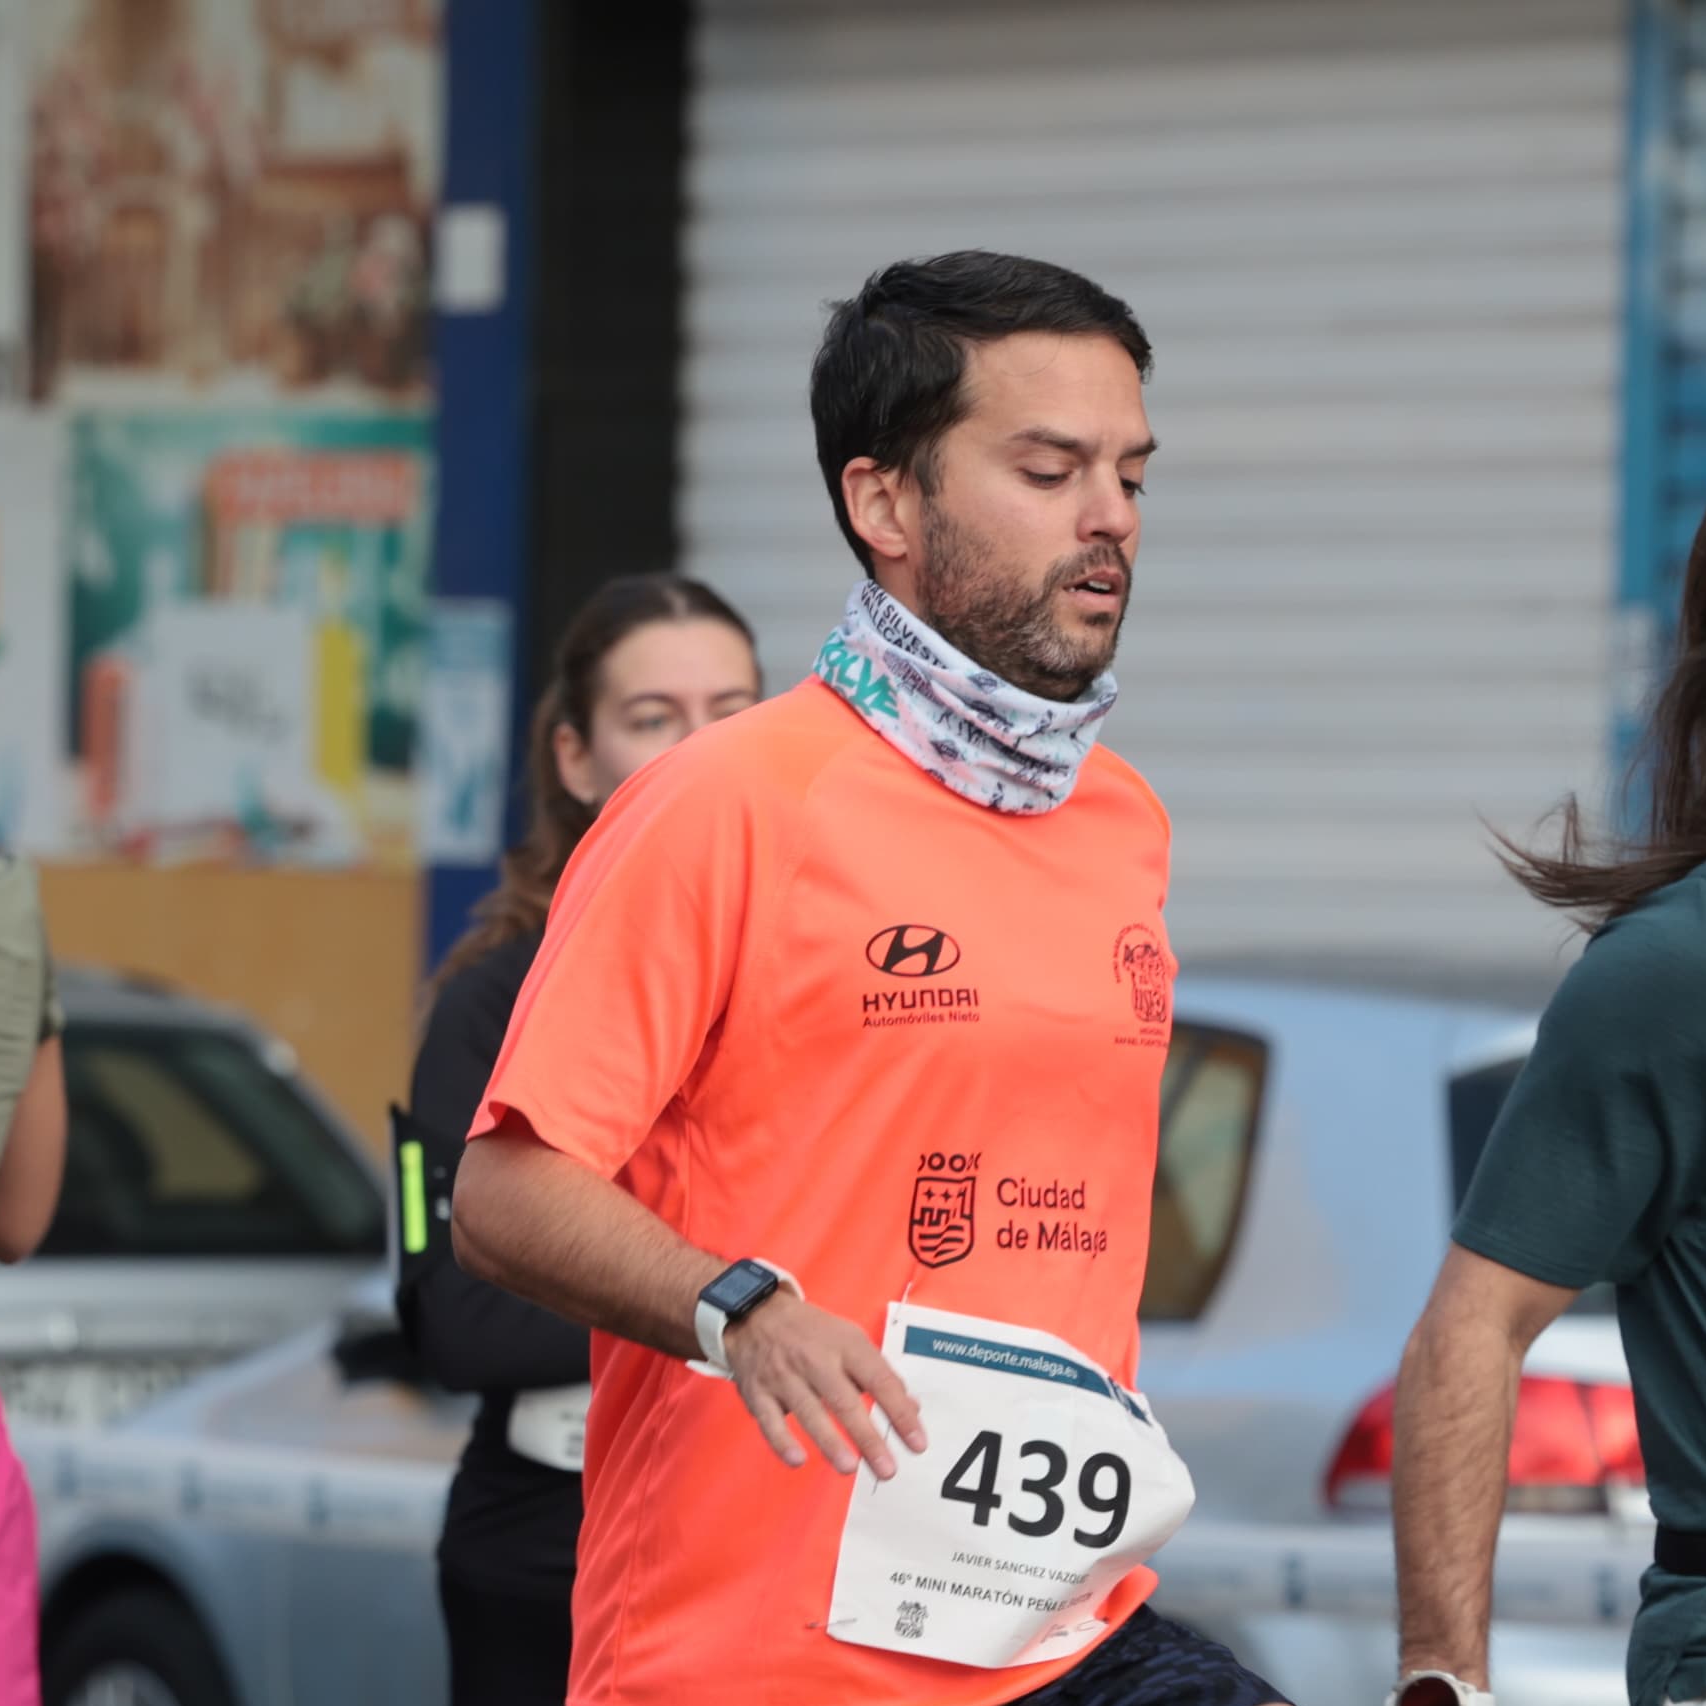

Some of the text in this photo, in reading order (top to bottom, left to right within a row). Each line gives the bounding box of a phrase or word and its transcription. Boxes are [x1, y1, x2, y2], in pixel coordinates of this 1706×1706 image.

[862, 989, 979, 1014] HYUNDAI
[862, 1011, 980, 1029] Automóviles Nieto
[996, 1177, 1086, 1209] Ciudad
[996, 1220, 1108, 1259] de Málaga
[932, 1338, 1078, 1380] www.deporte.malaga.eu
[941, 1430, 1131, 1549] 439
[951, 1552, 992, 1569] JAVIER
[995, 1560, 1045, 1577] SANCHEZ
[915, 1576, 946, 1592] MINI
[950, 1581, 1023, 1608] MARATÓN
